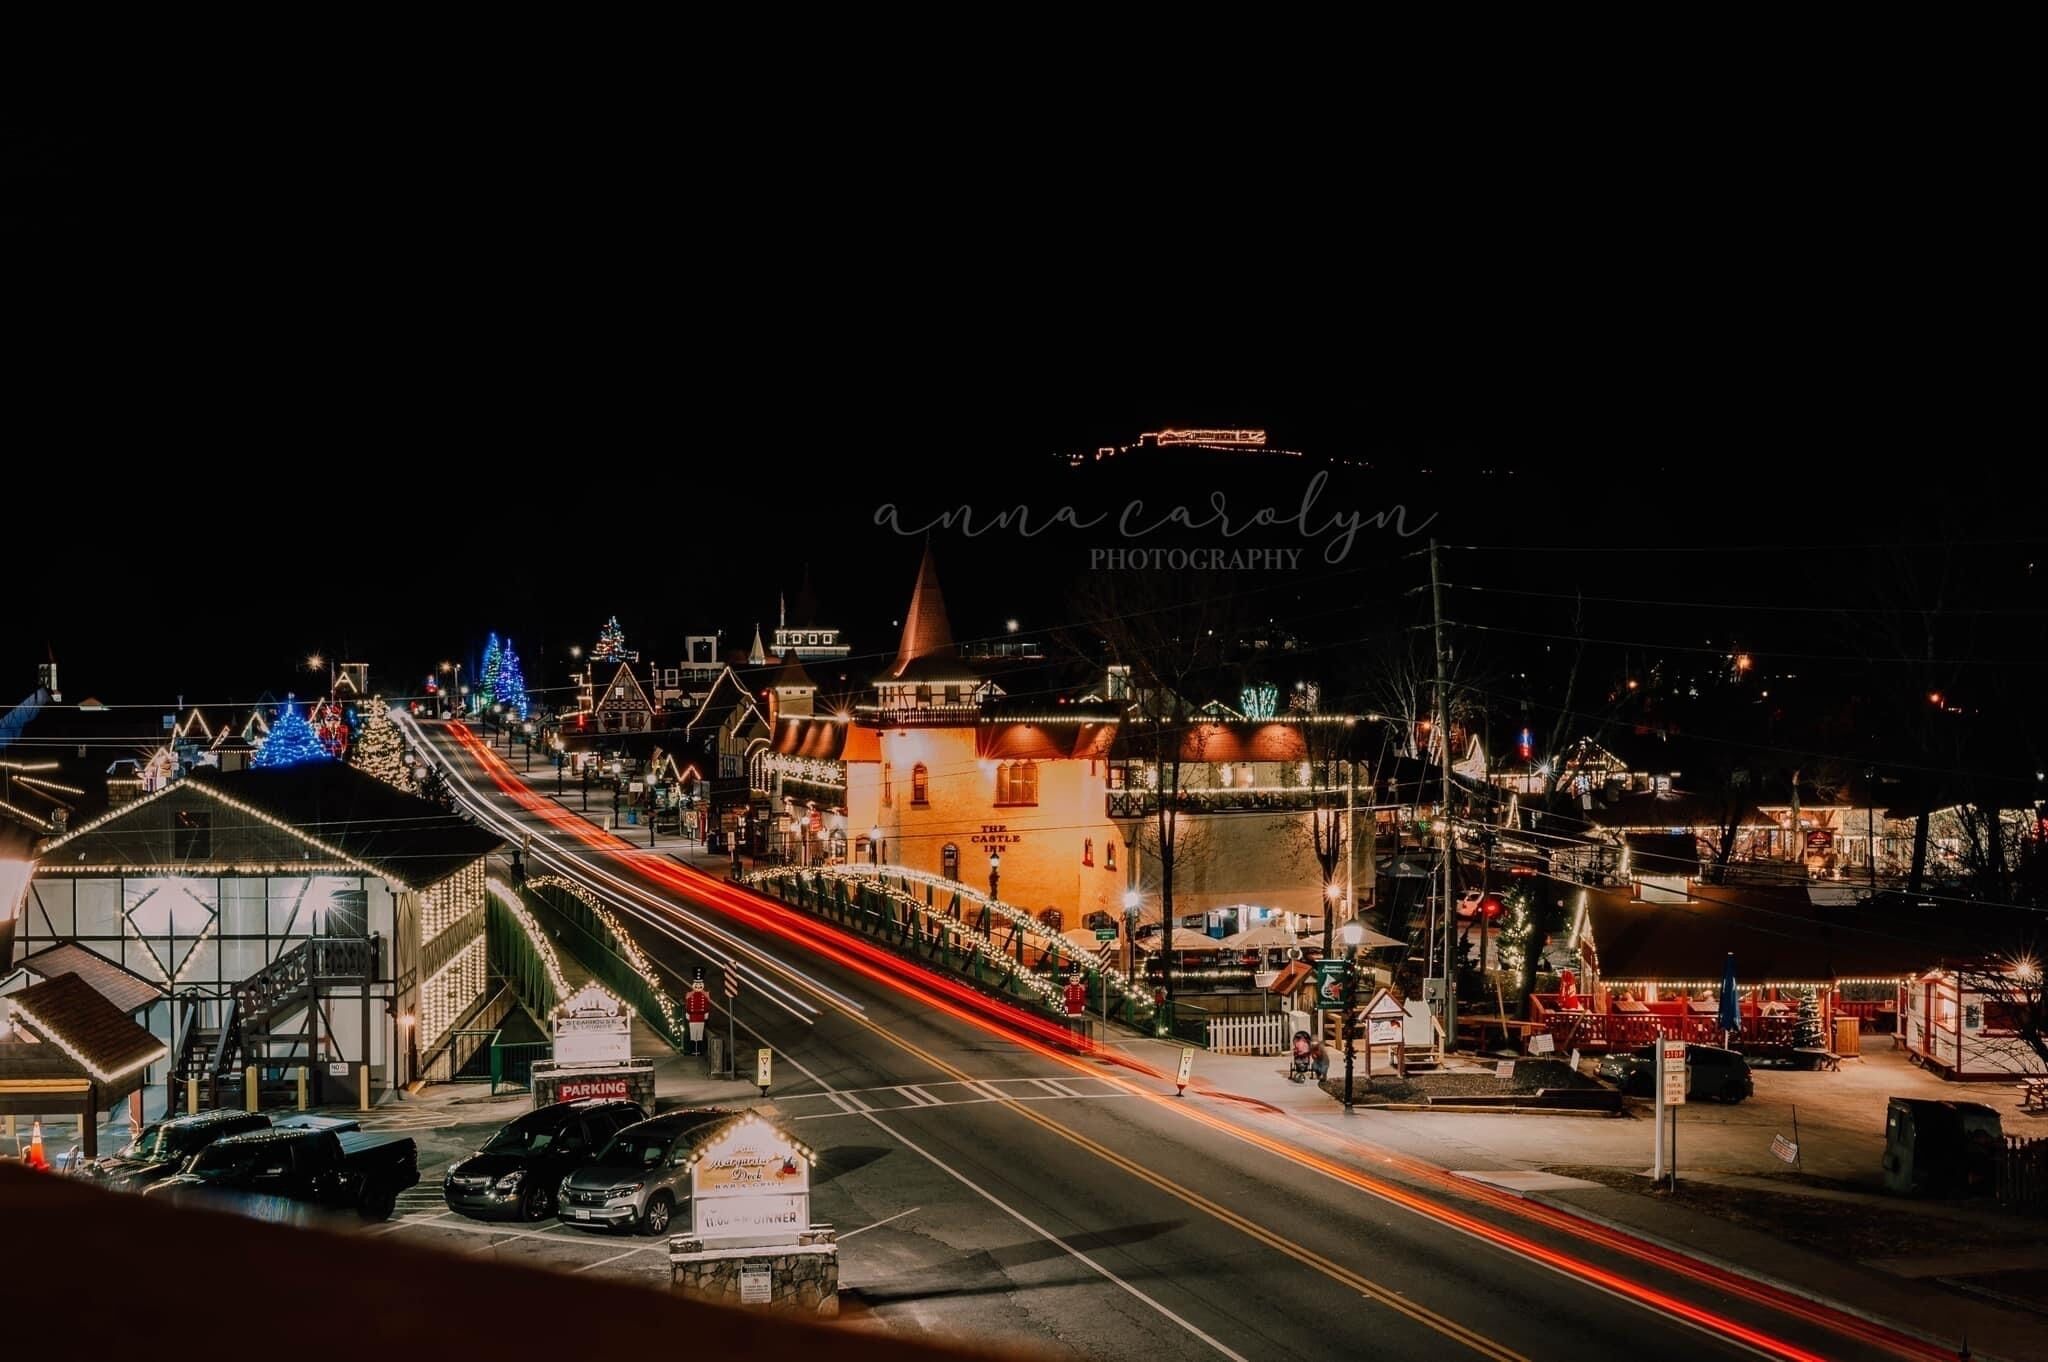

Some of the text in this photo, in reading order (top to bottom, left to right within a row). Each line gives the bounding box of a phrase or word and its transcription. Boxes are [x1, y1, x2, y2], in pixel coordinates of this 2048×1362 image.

[981, 825, 1007, 833] THE
[971, 835, 1021, 843] CASTLE
[984, 845, 1006, 853] INN
[562, 1082, 627, 1097] PARKING
